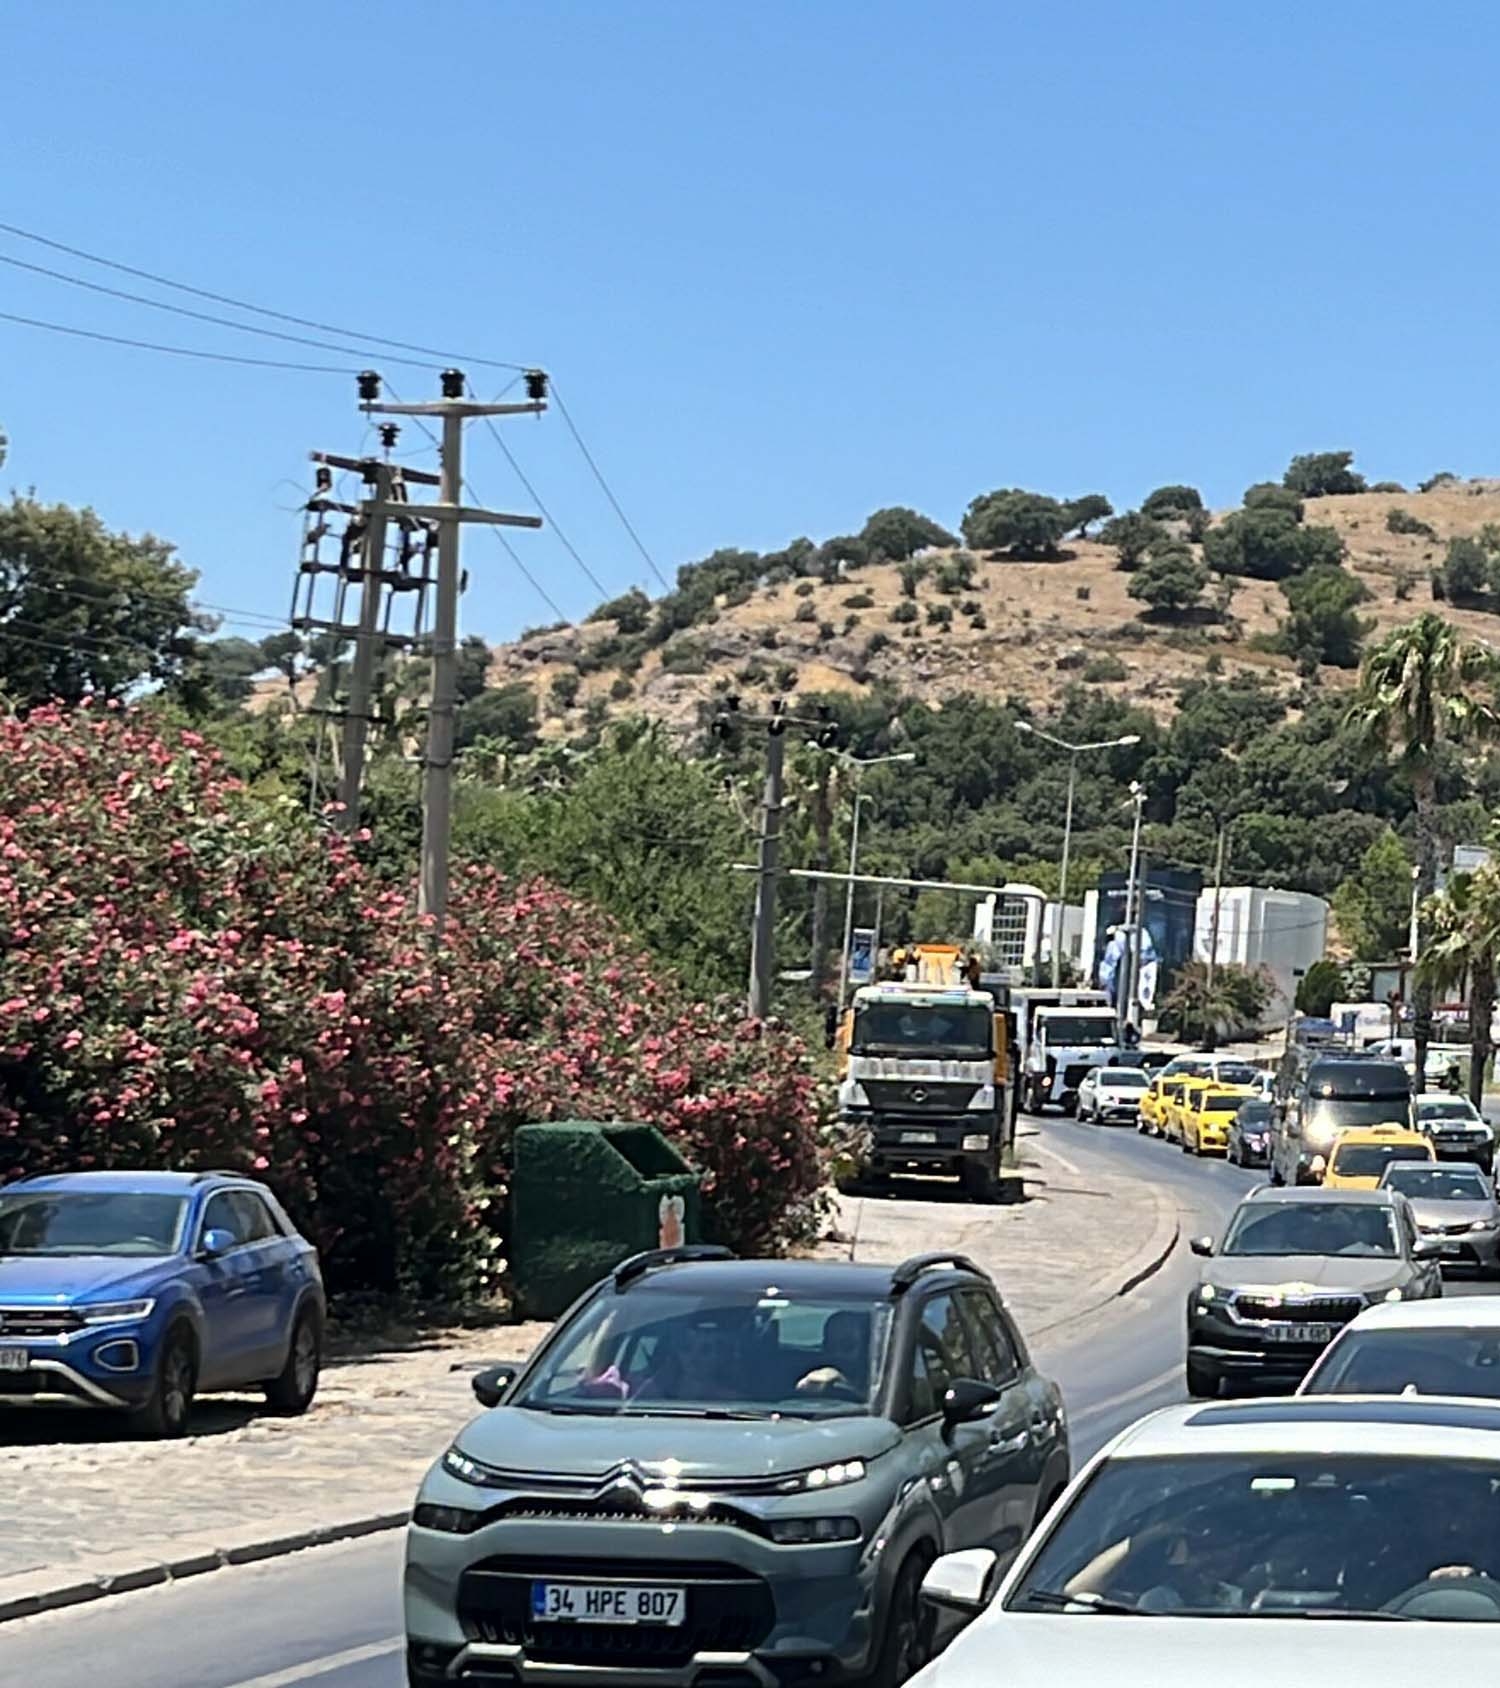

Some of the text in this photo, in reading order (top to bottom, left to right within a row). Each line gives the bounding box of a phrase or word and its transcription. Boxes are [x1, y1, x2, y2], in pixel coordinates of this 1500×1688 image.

[549, 1588, 679, 1616] 34 HPE 807
